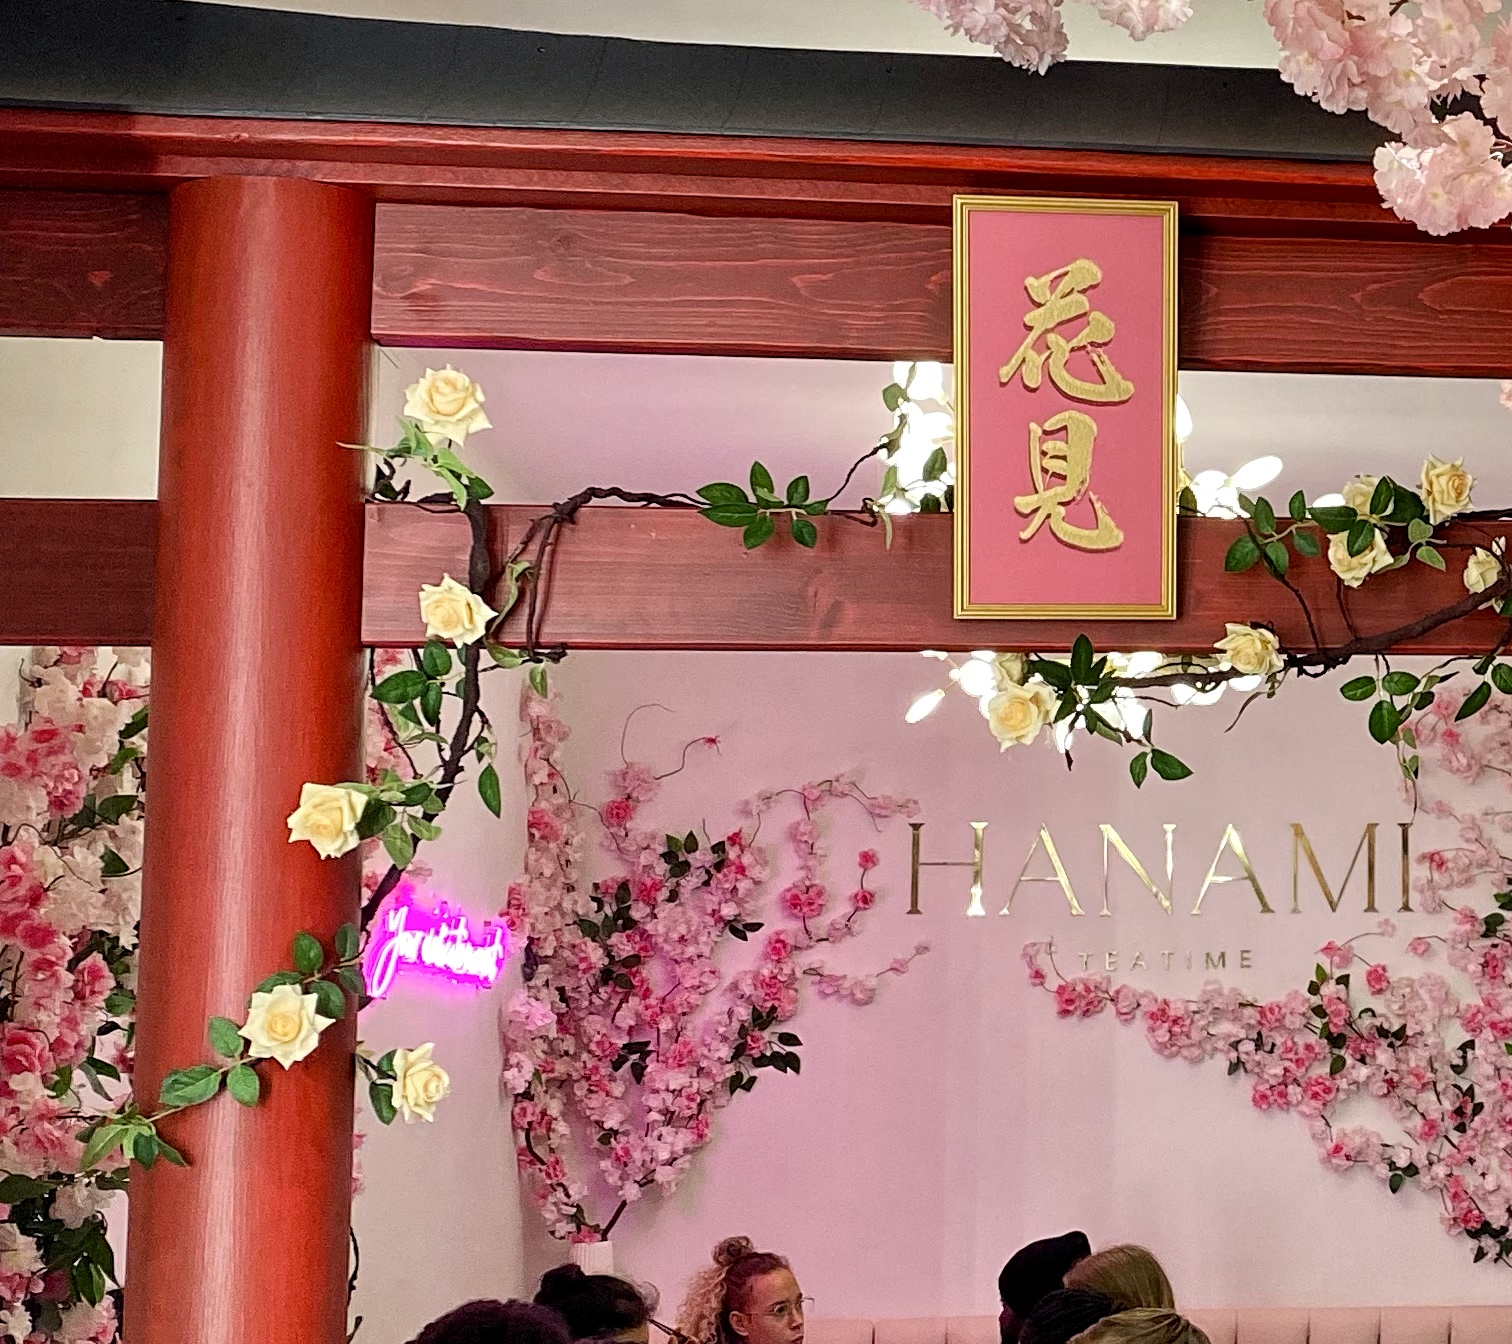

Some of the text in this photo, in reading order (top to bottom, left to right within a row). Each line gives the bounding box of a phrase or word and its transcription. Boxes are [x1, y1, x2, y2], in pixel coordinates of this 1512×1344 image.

[998, 258, 1135, 552] 花見
[906, 821, 1416, 917] HANAMI
[1078, 949, 1253, 972] TEATIME
